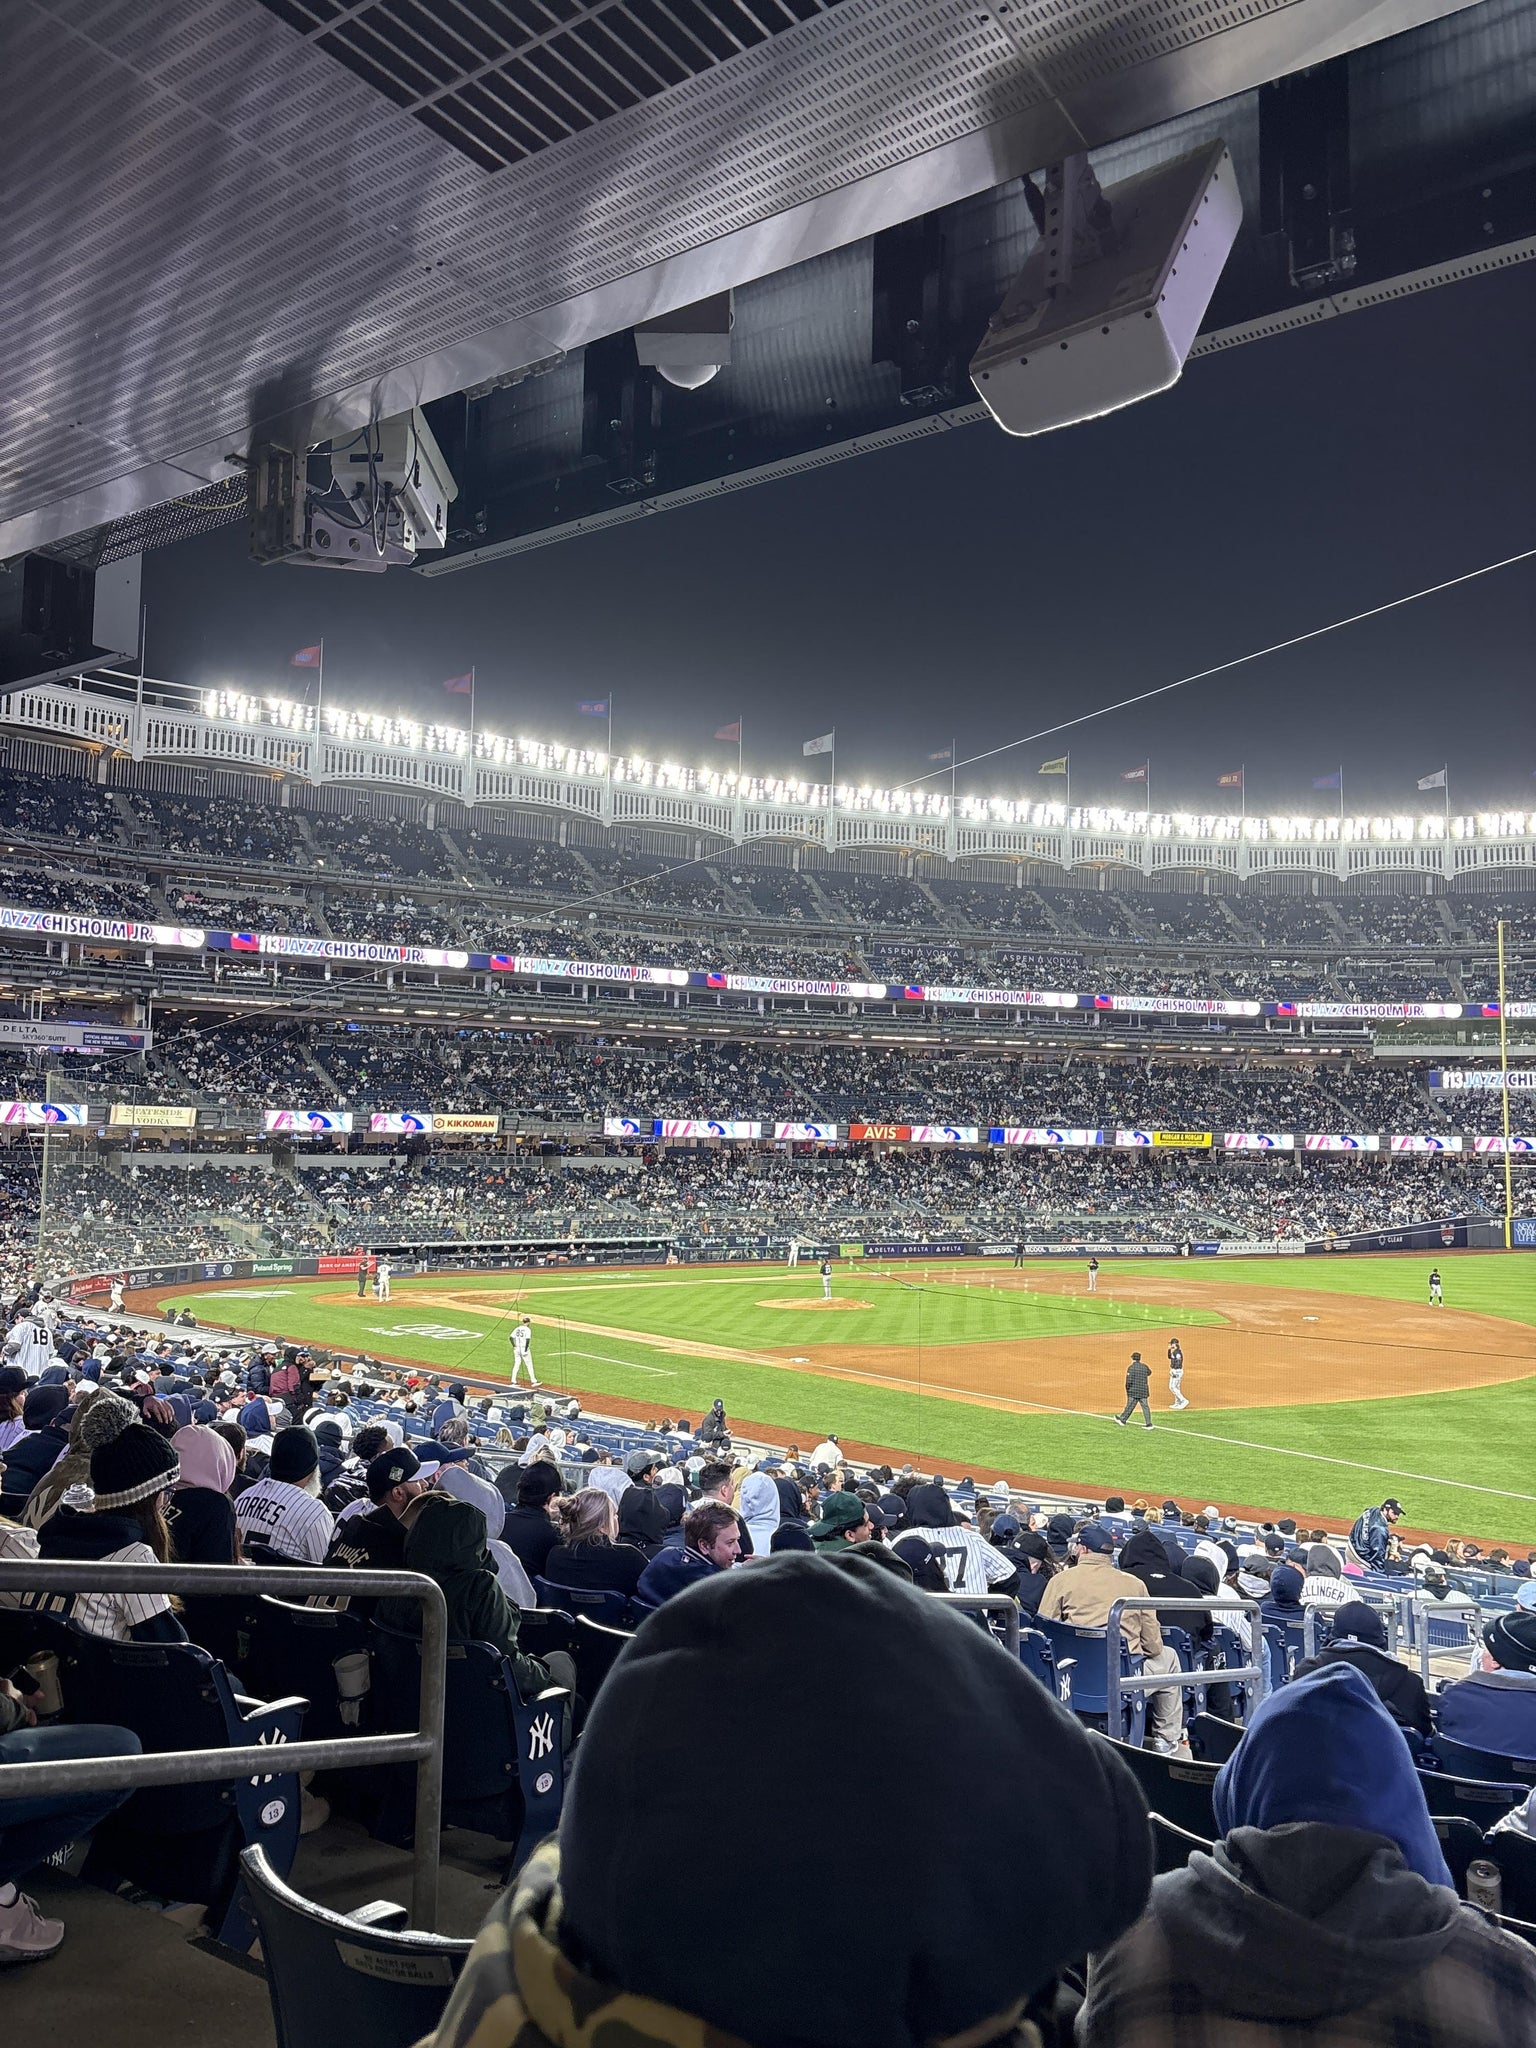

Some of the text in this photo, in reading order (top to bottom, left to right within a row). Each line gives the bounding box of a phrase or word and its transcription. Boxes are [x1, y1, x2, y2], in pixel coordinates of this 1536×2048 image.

[0, 908, 156, 942] AZZ CHISHOLM JR.
[282, 938, 323, 956] JAZZ
[324, 943, 399, 962] CHISHOLM
[405, 948, 426, 964] JR.
[880, 946, 914, 956] ASPEN
[1003, 954, 1035, 963] ASPEN
[569, 962, 632, 980] CHISHOLM
[774, 980, 833, 995] CHISHOLM
[971, 990, 1027, 1004] CHISHOLM
[1157, 1000, 1208, 1013] CHISHOLM
[1345, 1004, 1404, 1017] CHISHOLM
[3, 1025, 38, 1033] DELTA
[1465, 1073, 1504, 1087] JAZZ
[125, 1106, 183, 1116] STATESIDE
[136, 1117, 170, 1125] VODKA
[447, 1120, 495, 1128] KIKKOMAN
[864, 1126, 897, 1139] AVIS
[1185, 1134, 1203, 1142] MORGAN
[736, 1236, 760, 1244] StubHub
[252, 1262, 293, 1273] Poland Spring
[33, 1328, 48, 1345] 18
[237, 1496, 286, 1526] TORRES
[1299, 1584, 1346, 1602] ELLINGER
[528, 1711, 554, 1761] NY
[268, 1808, 280, 1821] 13
